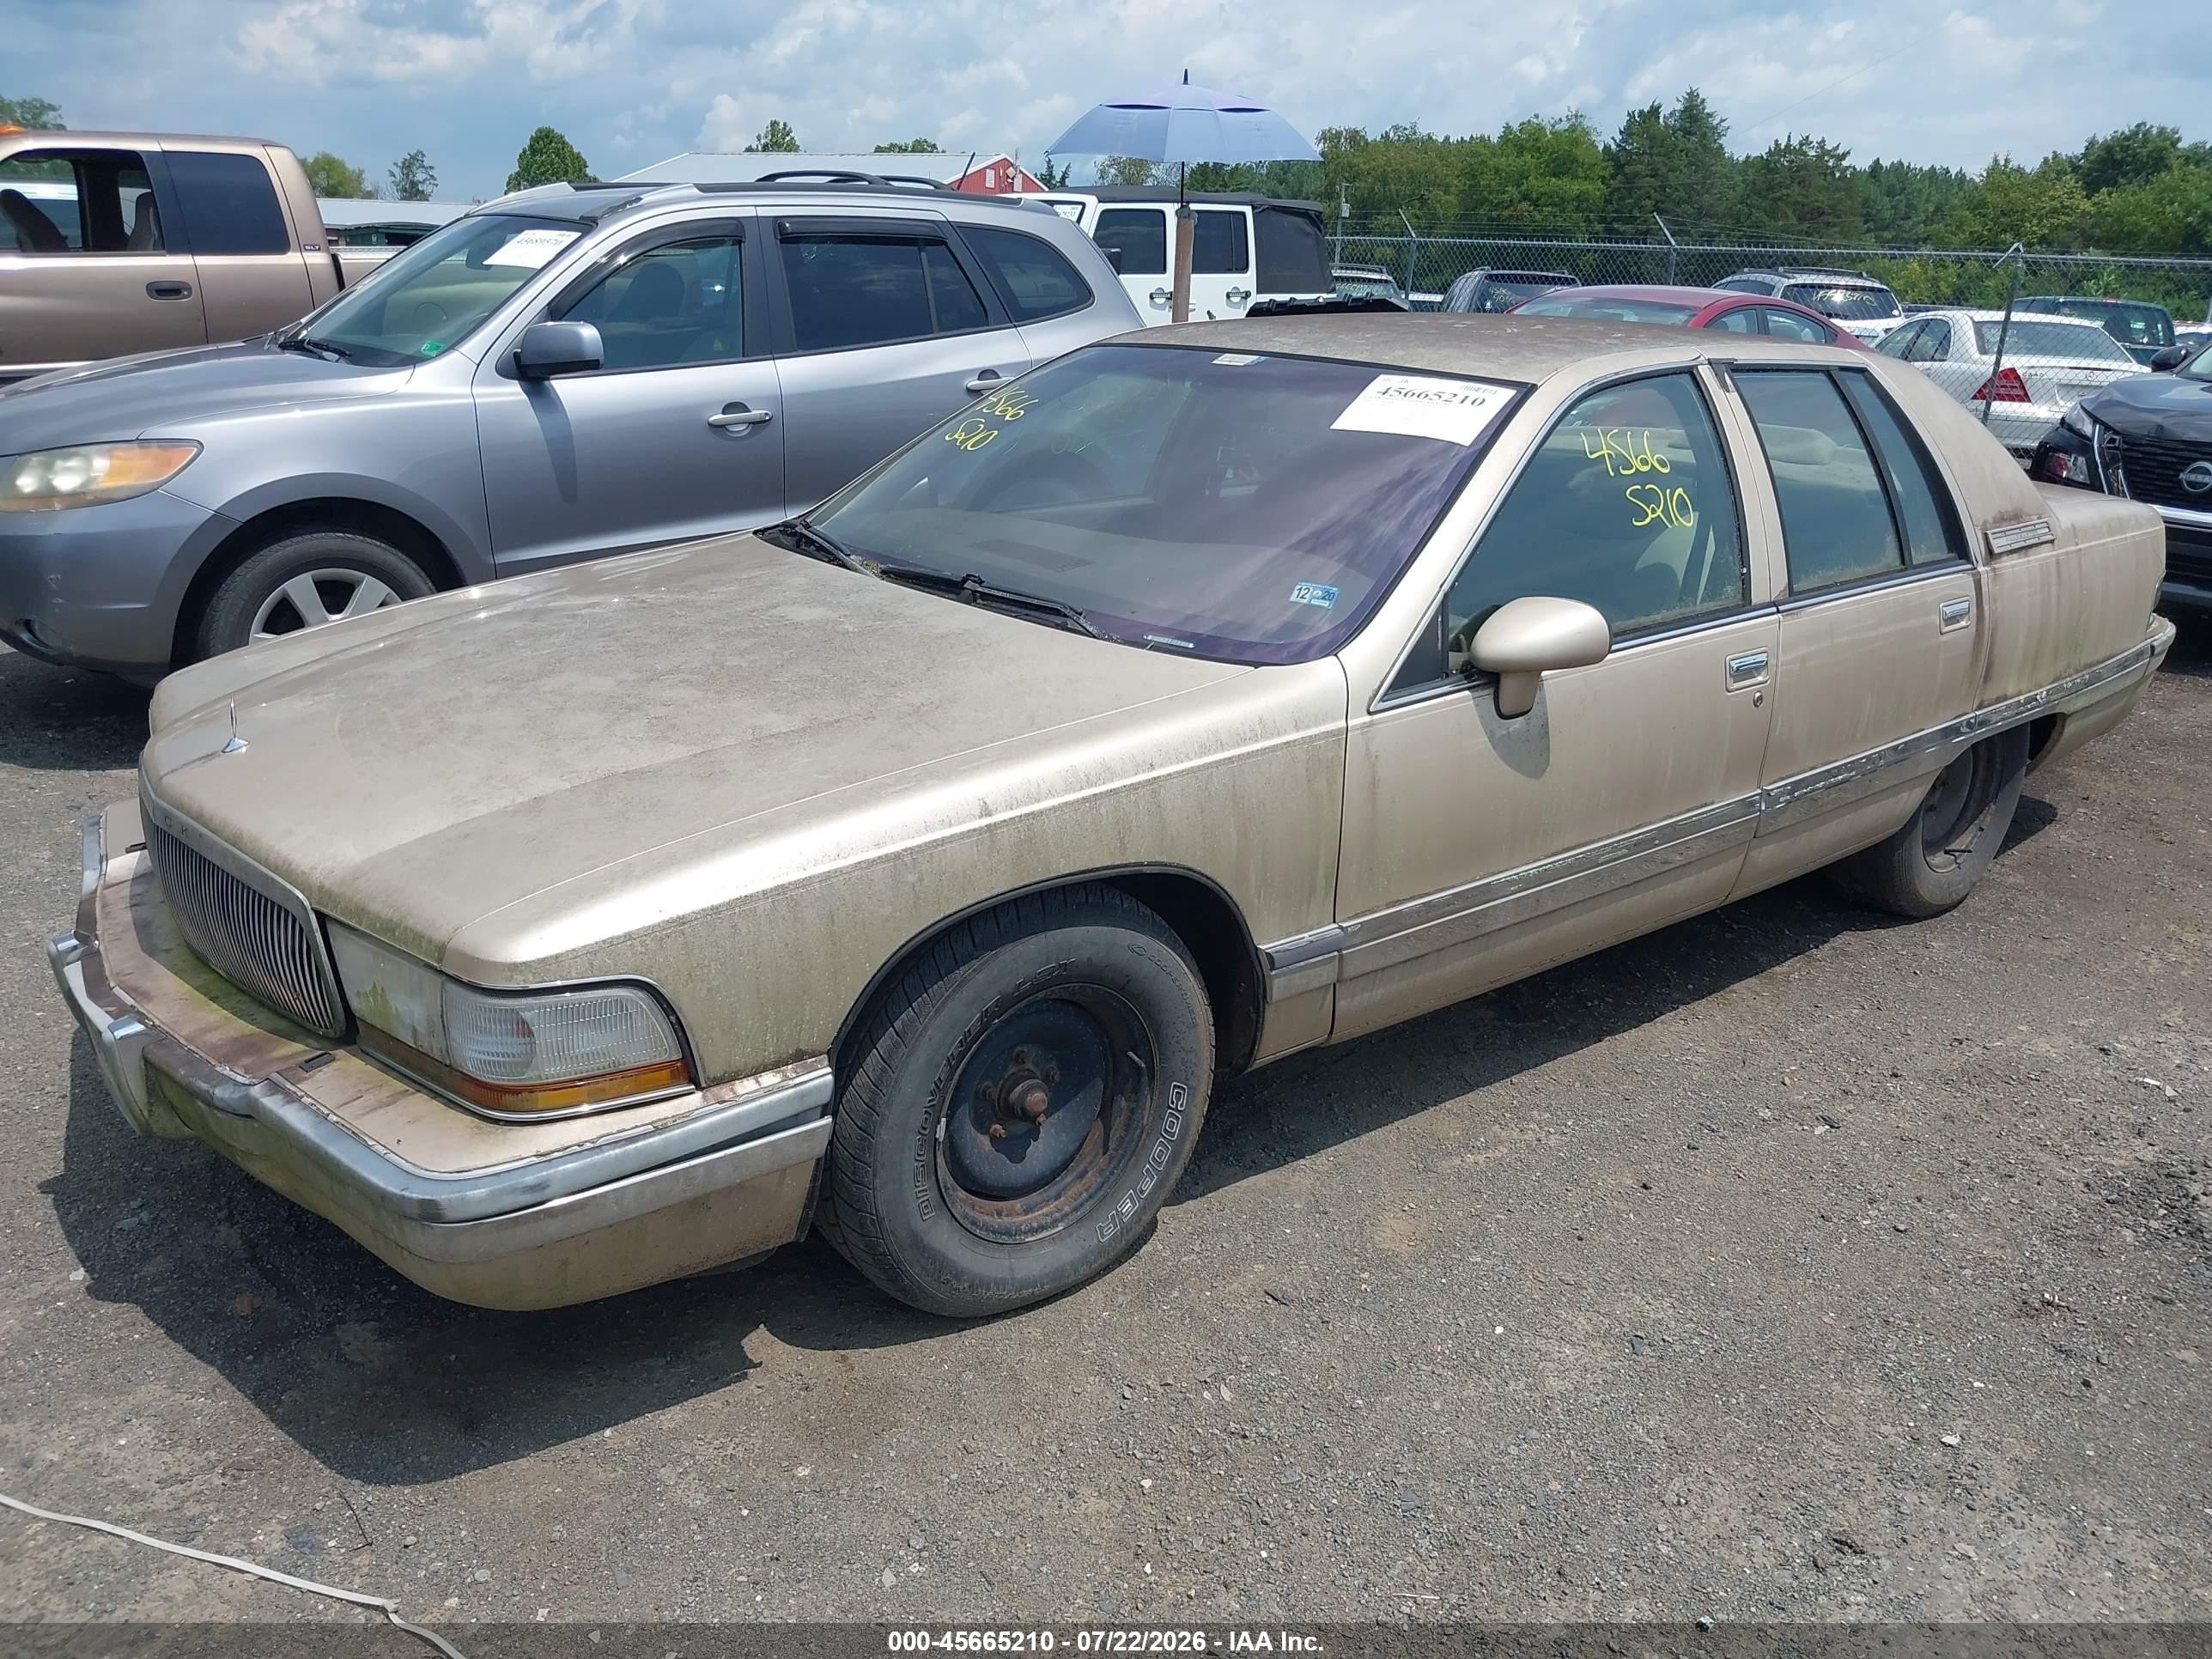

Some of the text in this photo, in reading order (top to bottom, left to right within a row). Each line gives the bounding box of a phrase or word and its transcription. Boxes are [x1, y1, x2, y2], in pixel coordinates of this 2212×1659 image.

[1376, 386, 1486, 407] 45665210
[945, 418, 999, 451] 5210
[1580, 428, 1671, 477] 4566
[2179, 472, 2212, 483] NISSA
[1626, 484, 1694, 528] 5210
[1296, 586, 1336, 601] 12 20
[914, 995, 1001, 1222] DISCOVERER
[1096, 1081, 1188, 1243] COOPER
